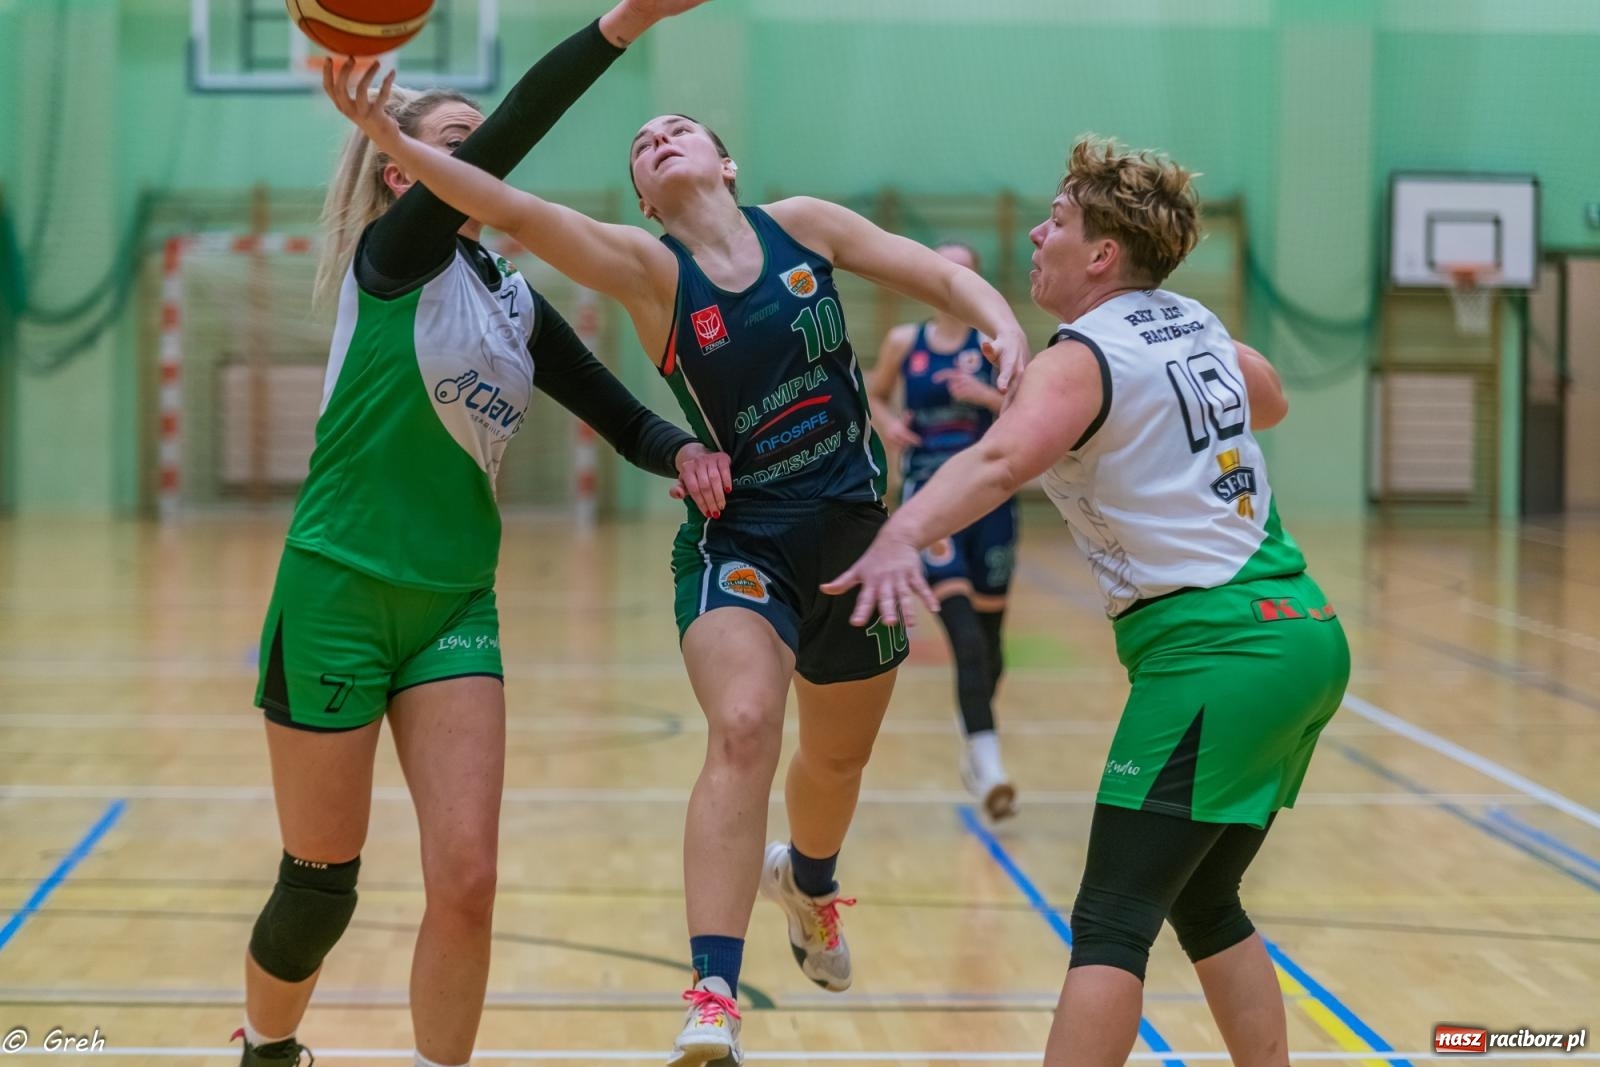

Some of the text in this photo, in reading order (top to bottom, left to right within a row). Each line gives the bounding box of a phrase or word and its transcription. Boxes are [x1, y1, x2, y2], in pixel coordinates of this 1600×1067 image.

[791, 297, 843, 363] 10
[465, 382, 528, 434] Clav
[734, 364, 829, 434] OLIMPIA
[1166, 352, 1246, 454] 10
[733, 430, 842, 485] ODZISŁAW
[755, 410, 829, 455] INFOSAFE
[320, 673, 355, 713] 7
